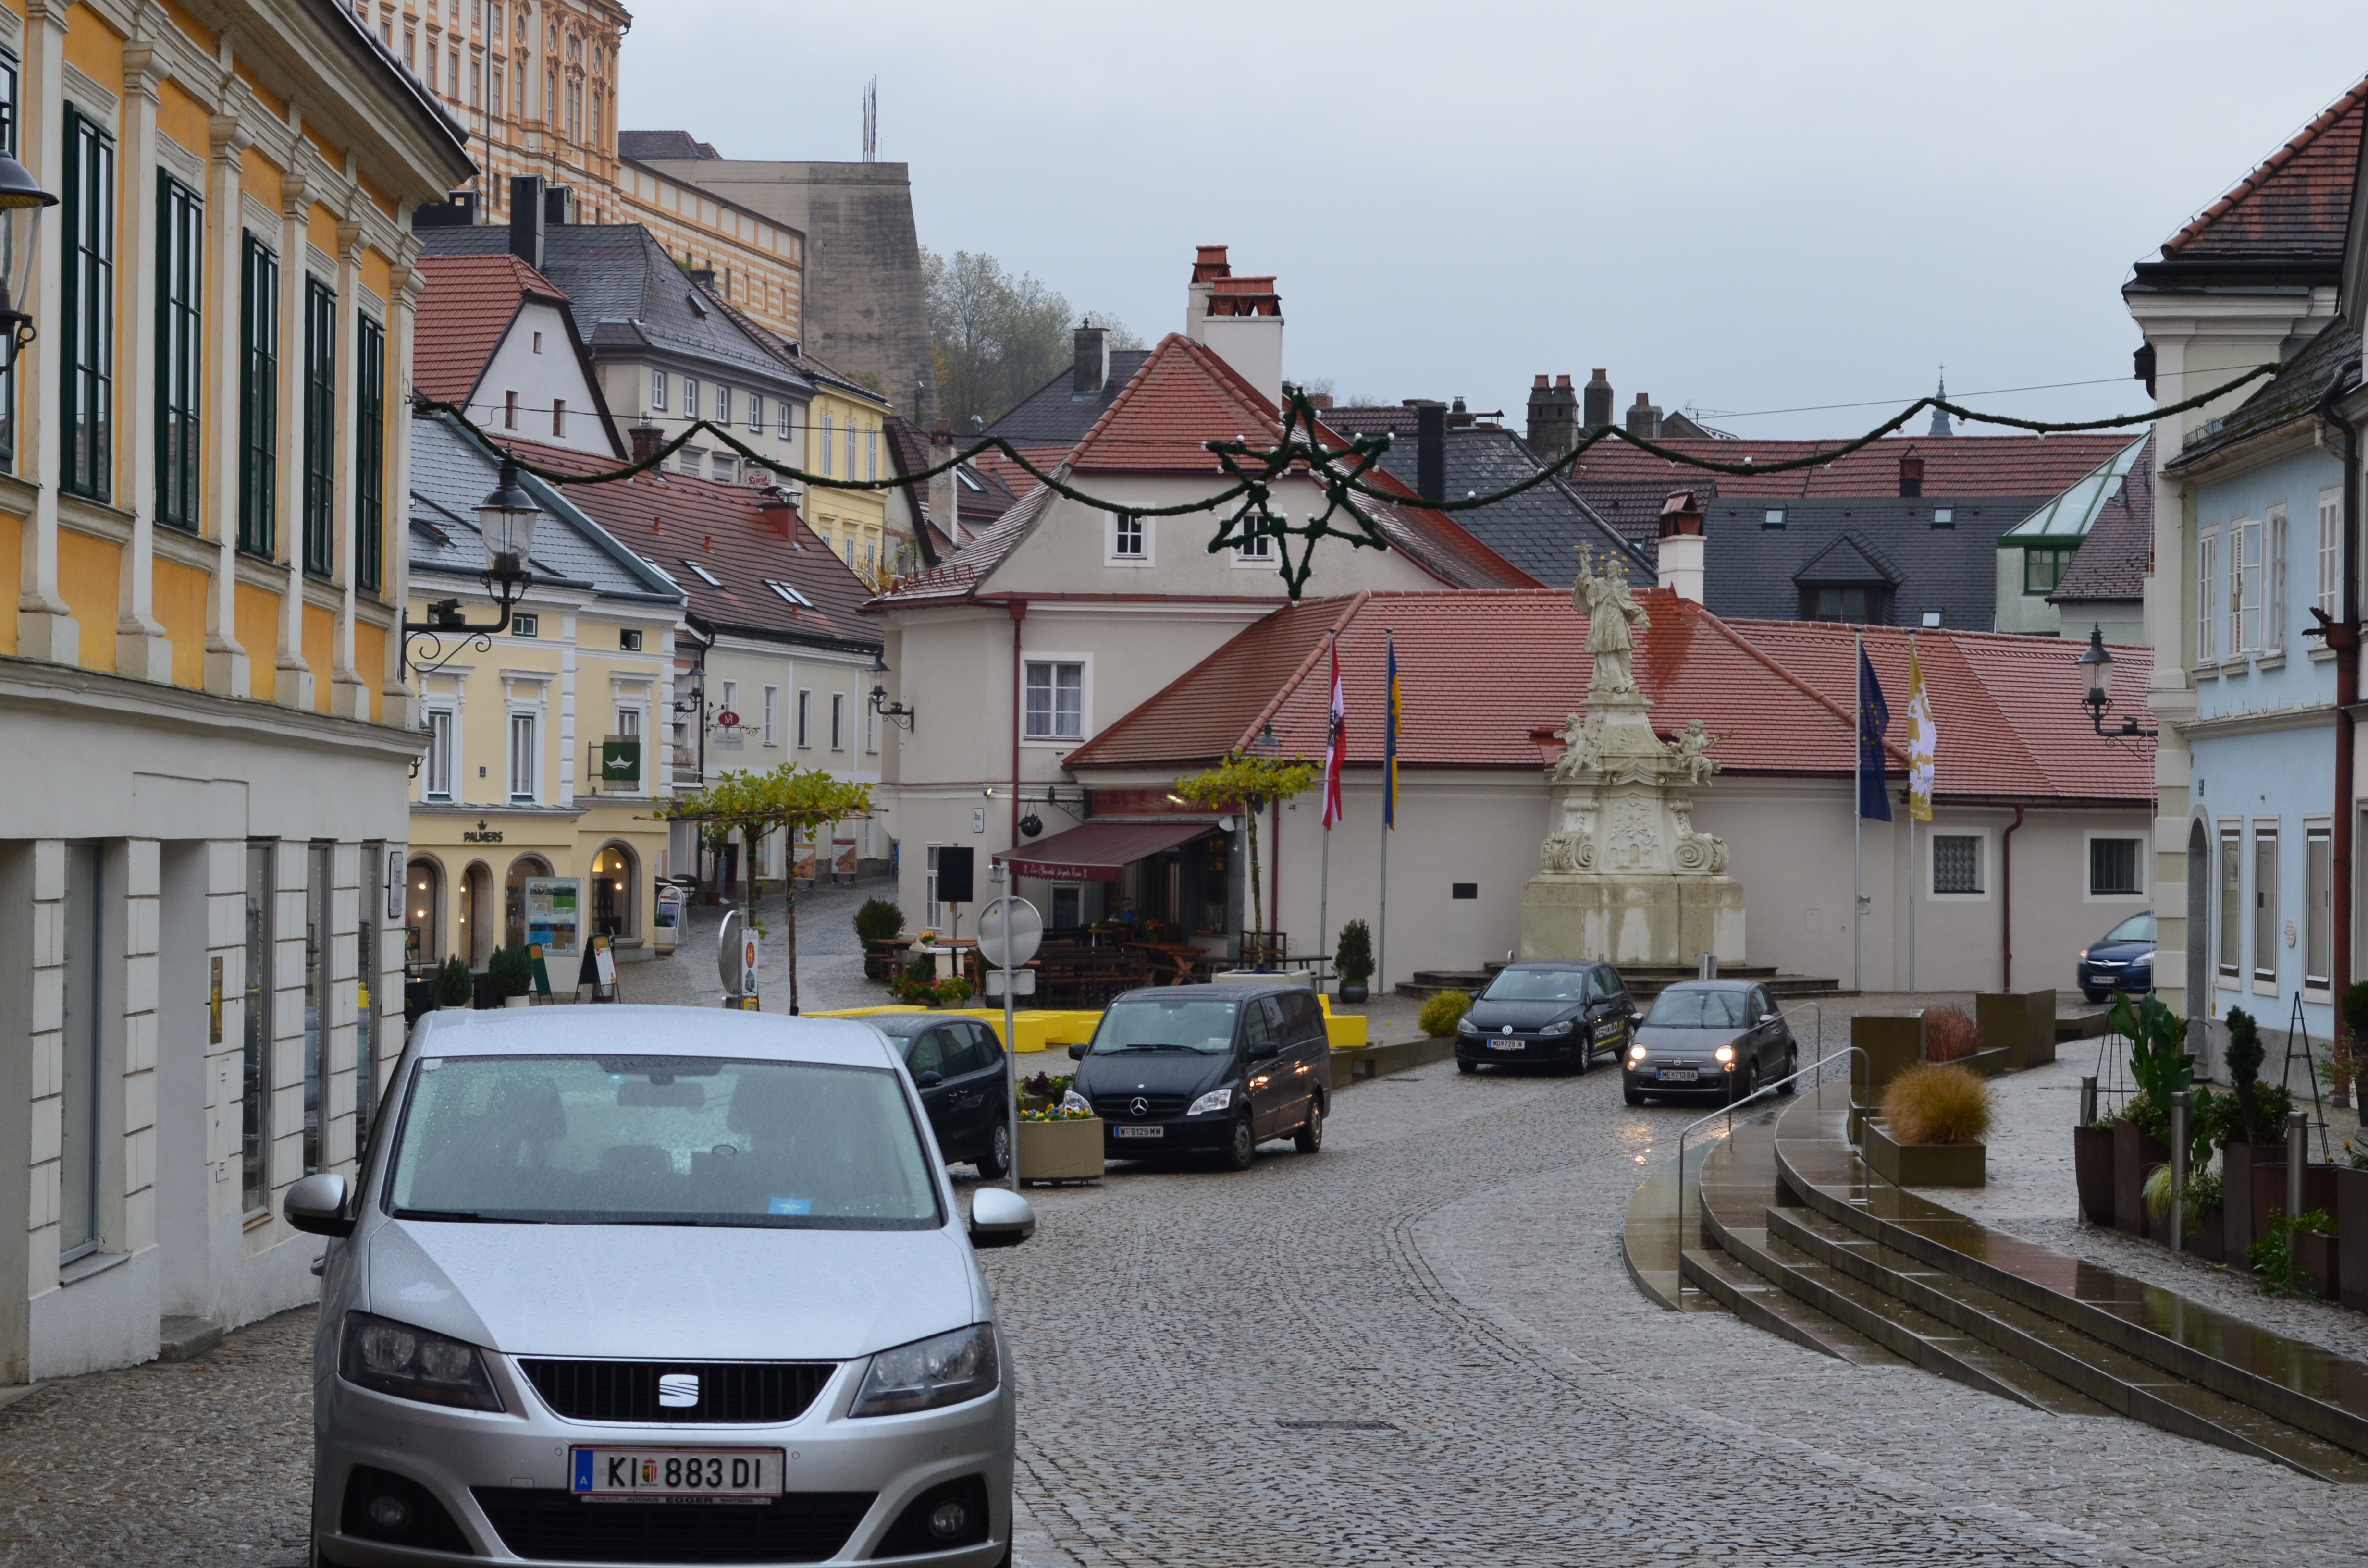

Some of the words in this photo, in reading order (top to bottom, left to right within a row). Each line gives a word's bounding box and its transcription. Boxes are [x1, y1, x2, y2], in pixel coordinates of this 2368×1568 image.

[464, 831, 503, 843] PALMERS
[748, 948, 753, 962] H
[1131, 1127, 1148, 1136] 9129
[580, 1476, 588, 1485] A
[608, 1456, 637, 1487] KI
[666, 1457, 722, 1488] 883
[732, 1458, 760, 1488] DI
